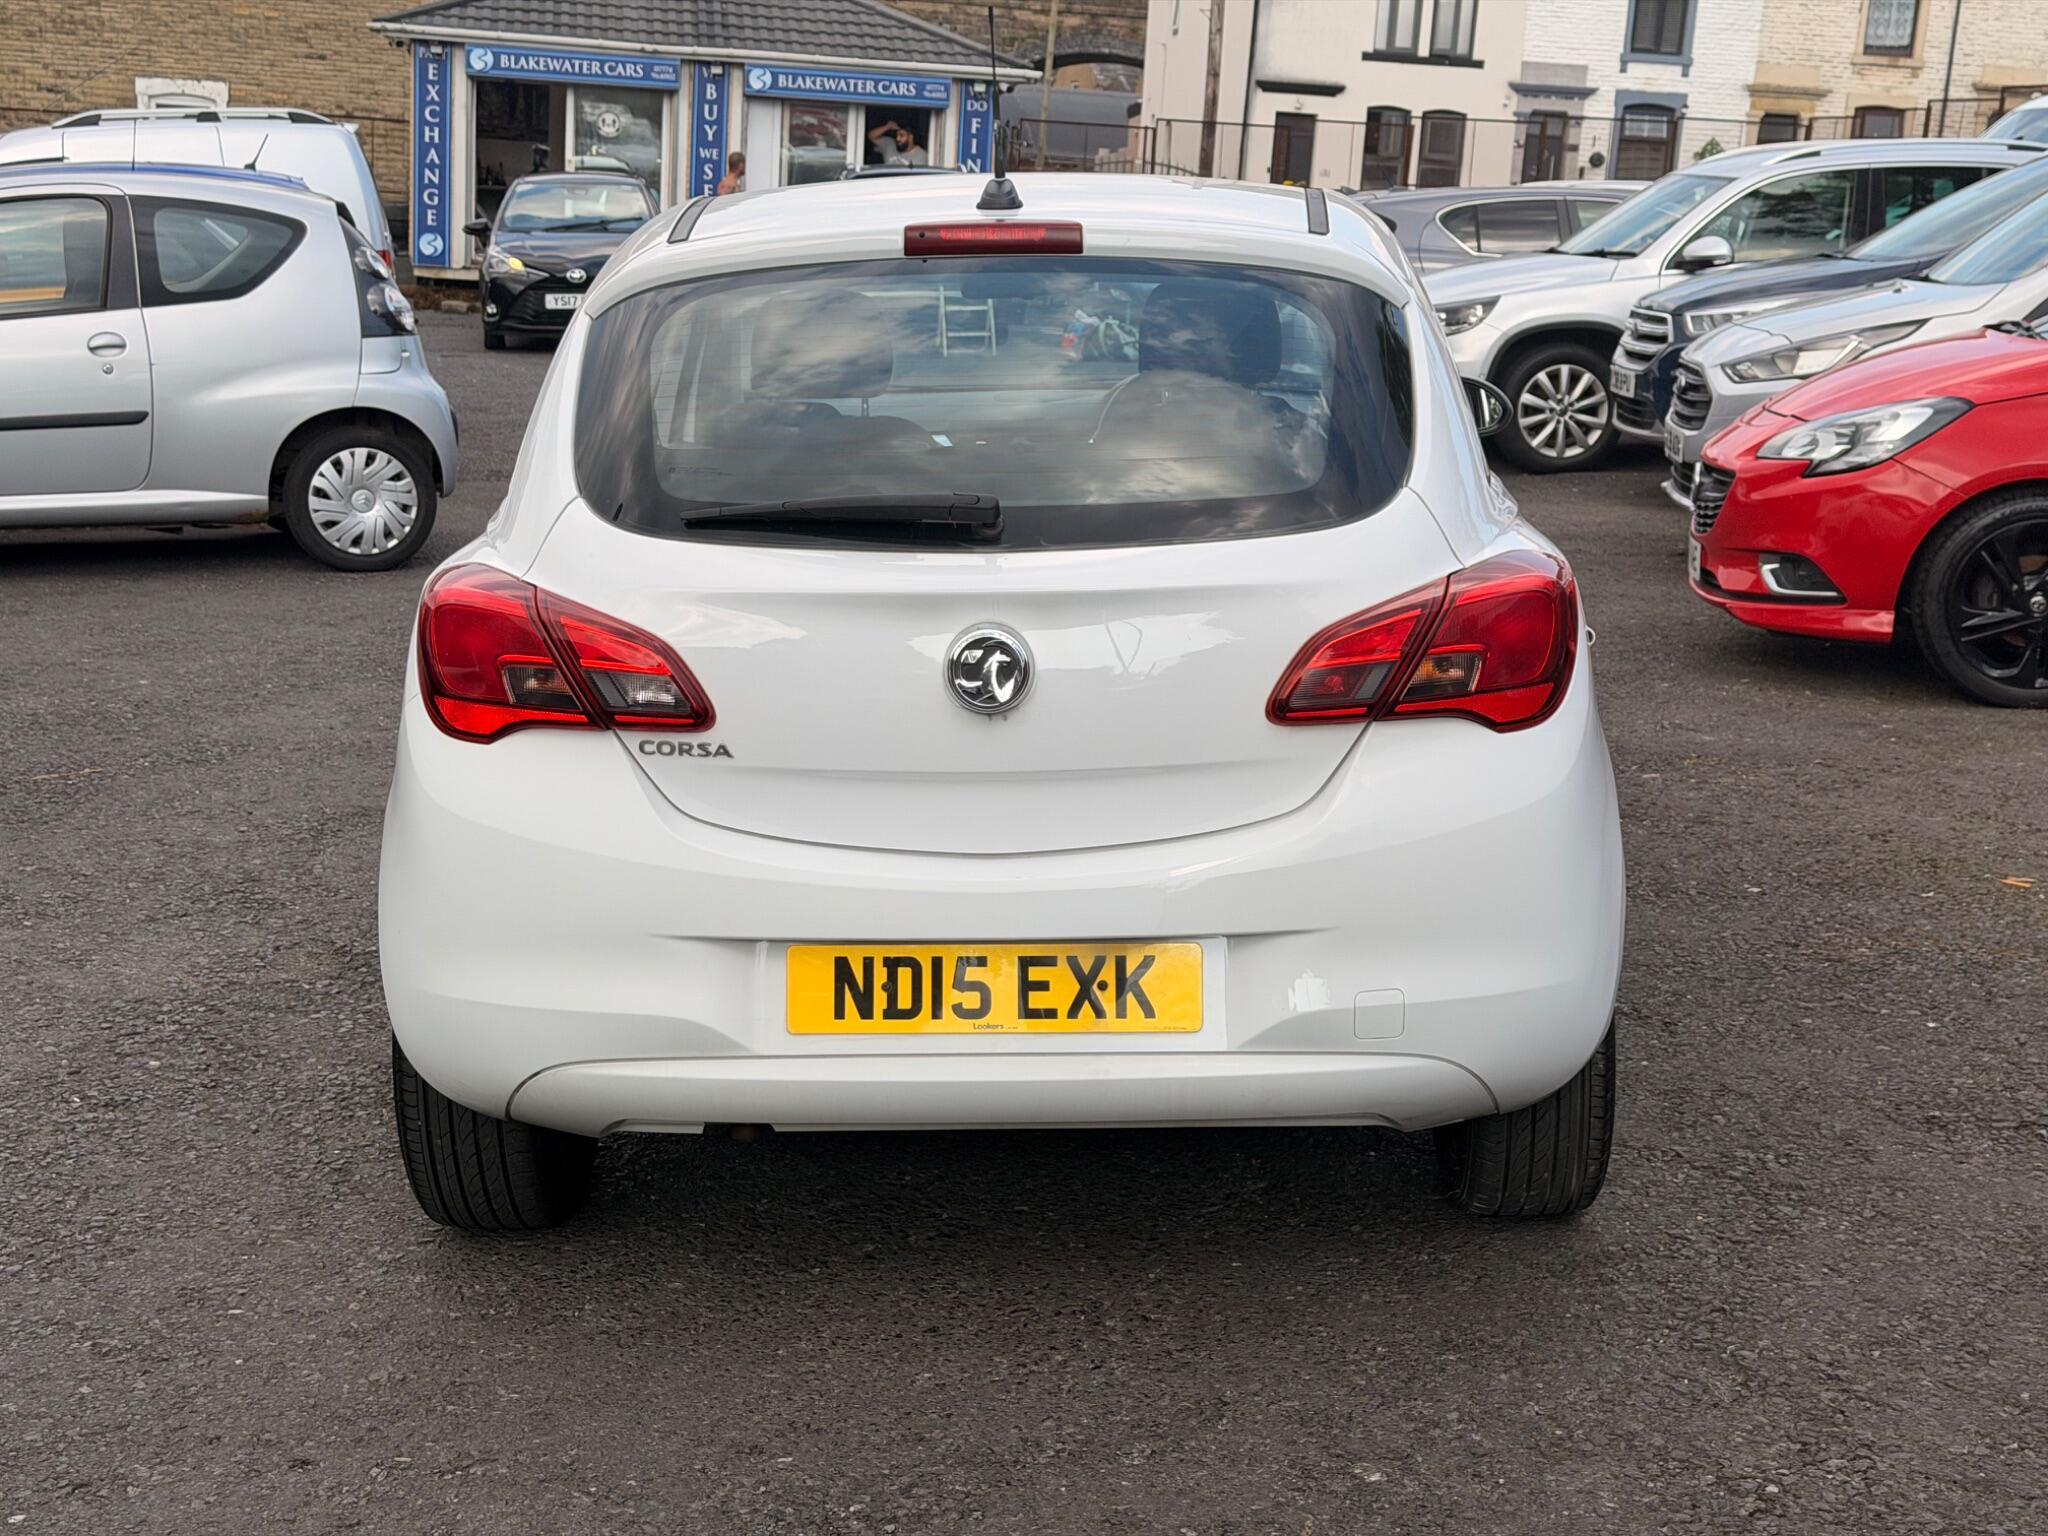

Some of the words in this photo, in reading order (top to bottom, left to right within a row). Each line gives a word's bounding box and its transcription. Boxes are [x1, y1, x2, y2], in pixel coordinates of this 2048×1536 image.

[499, 55, 604, 76] BLAKEWATER
[604, 61, 644, 78] CARS
[777, 73, 874, 93] BLAKEWATER
[877, 79, 917, 96] CARS
[703, 83, 718, 141] BUY
[966, 99, 988, 112] DO
[422, 63, 441, 226] EXCHANGE
[699, 147, 720, 160] WE
[552, 295, 578, 306] YS17
[638, 739, 735, 759] CORSA
[833, 955, 992, 1021] ND15
[1016, 954, 1157, 1020] EXK
[972, 1022, 1005, 1031] Lookers
